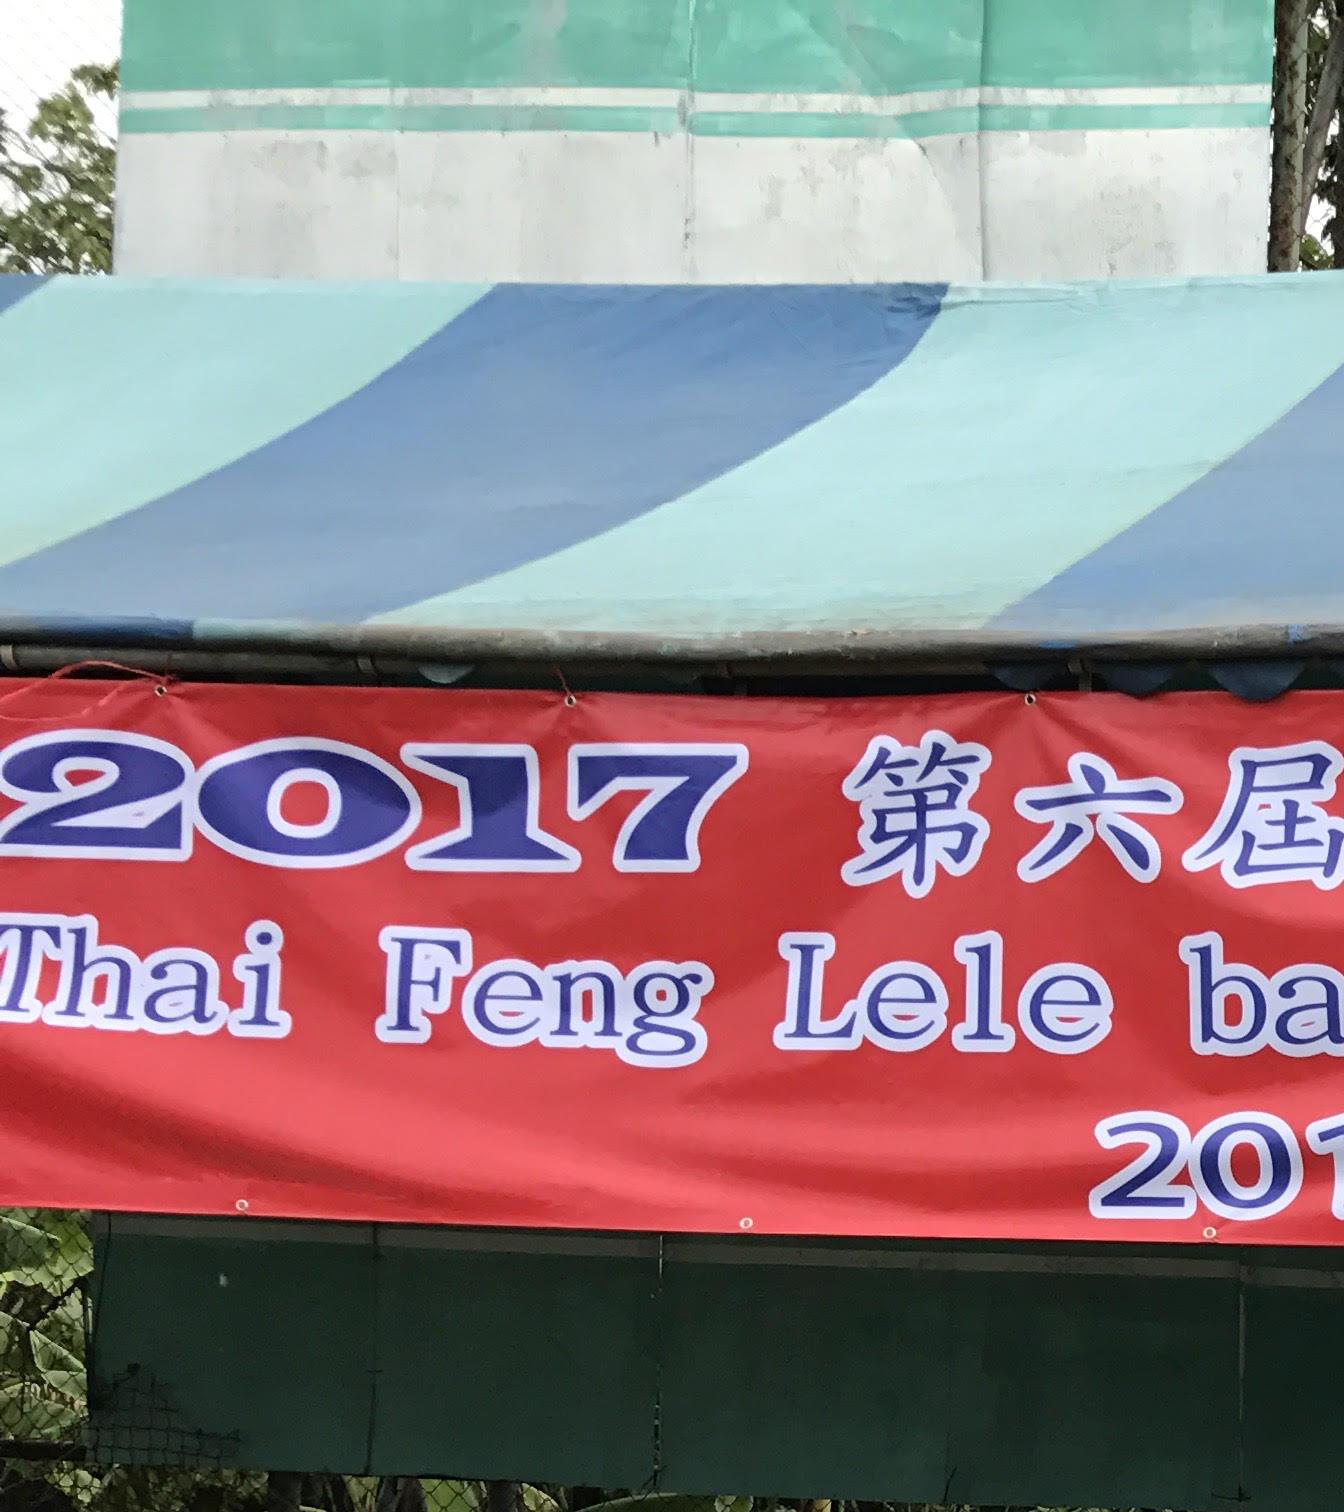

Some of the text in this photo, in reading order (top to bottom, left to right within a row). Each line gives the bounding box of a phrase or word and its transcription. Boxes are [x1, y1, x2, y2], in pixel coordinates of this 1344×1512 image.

[0, 729, 748, 872] 2017
[0, 913, 291, 1038] Thai
[376, 926, 714, 1068] Feng
[774, 931, 1113, 1053] Lele
